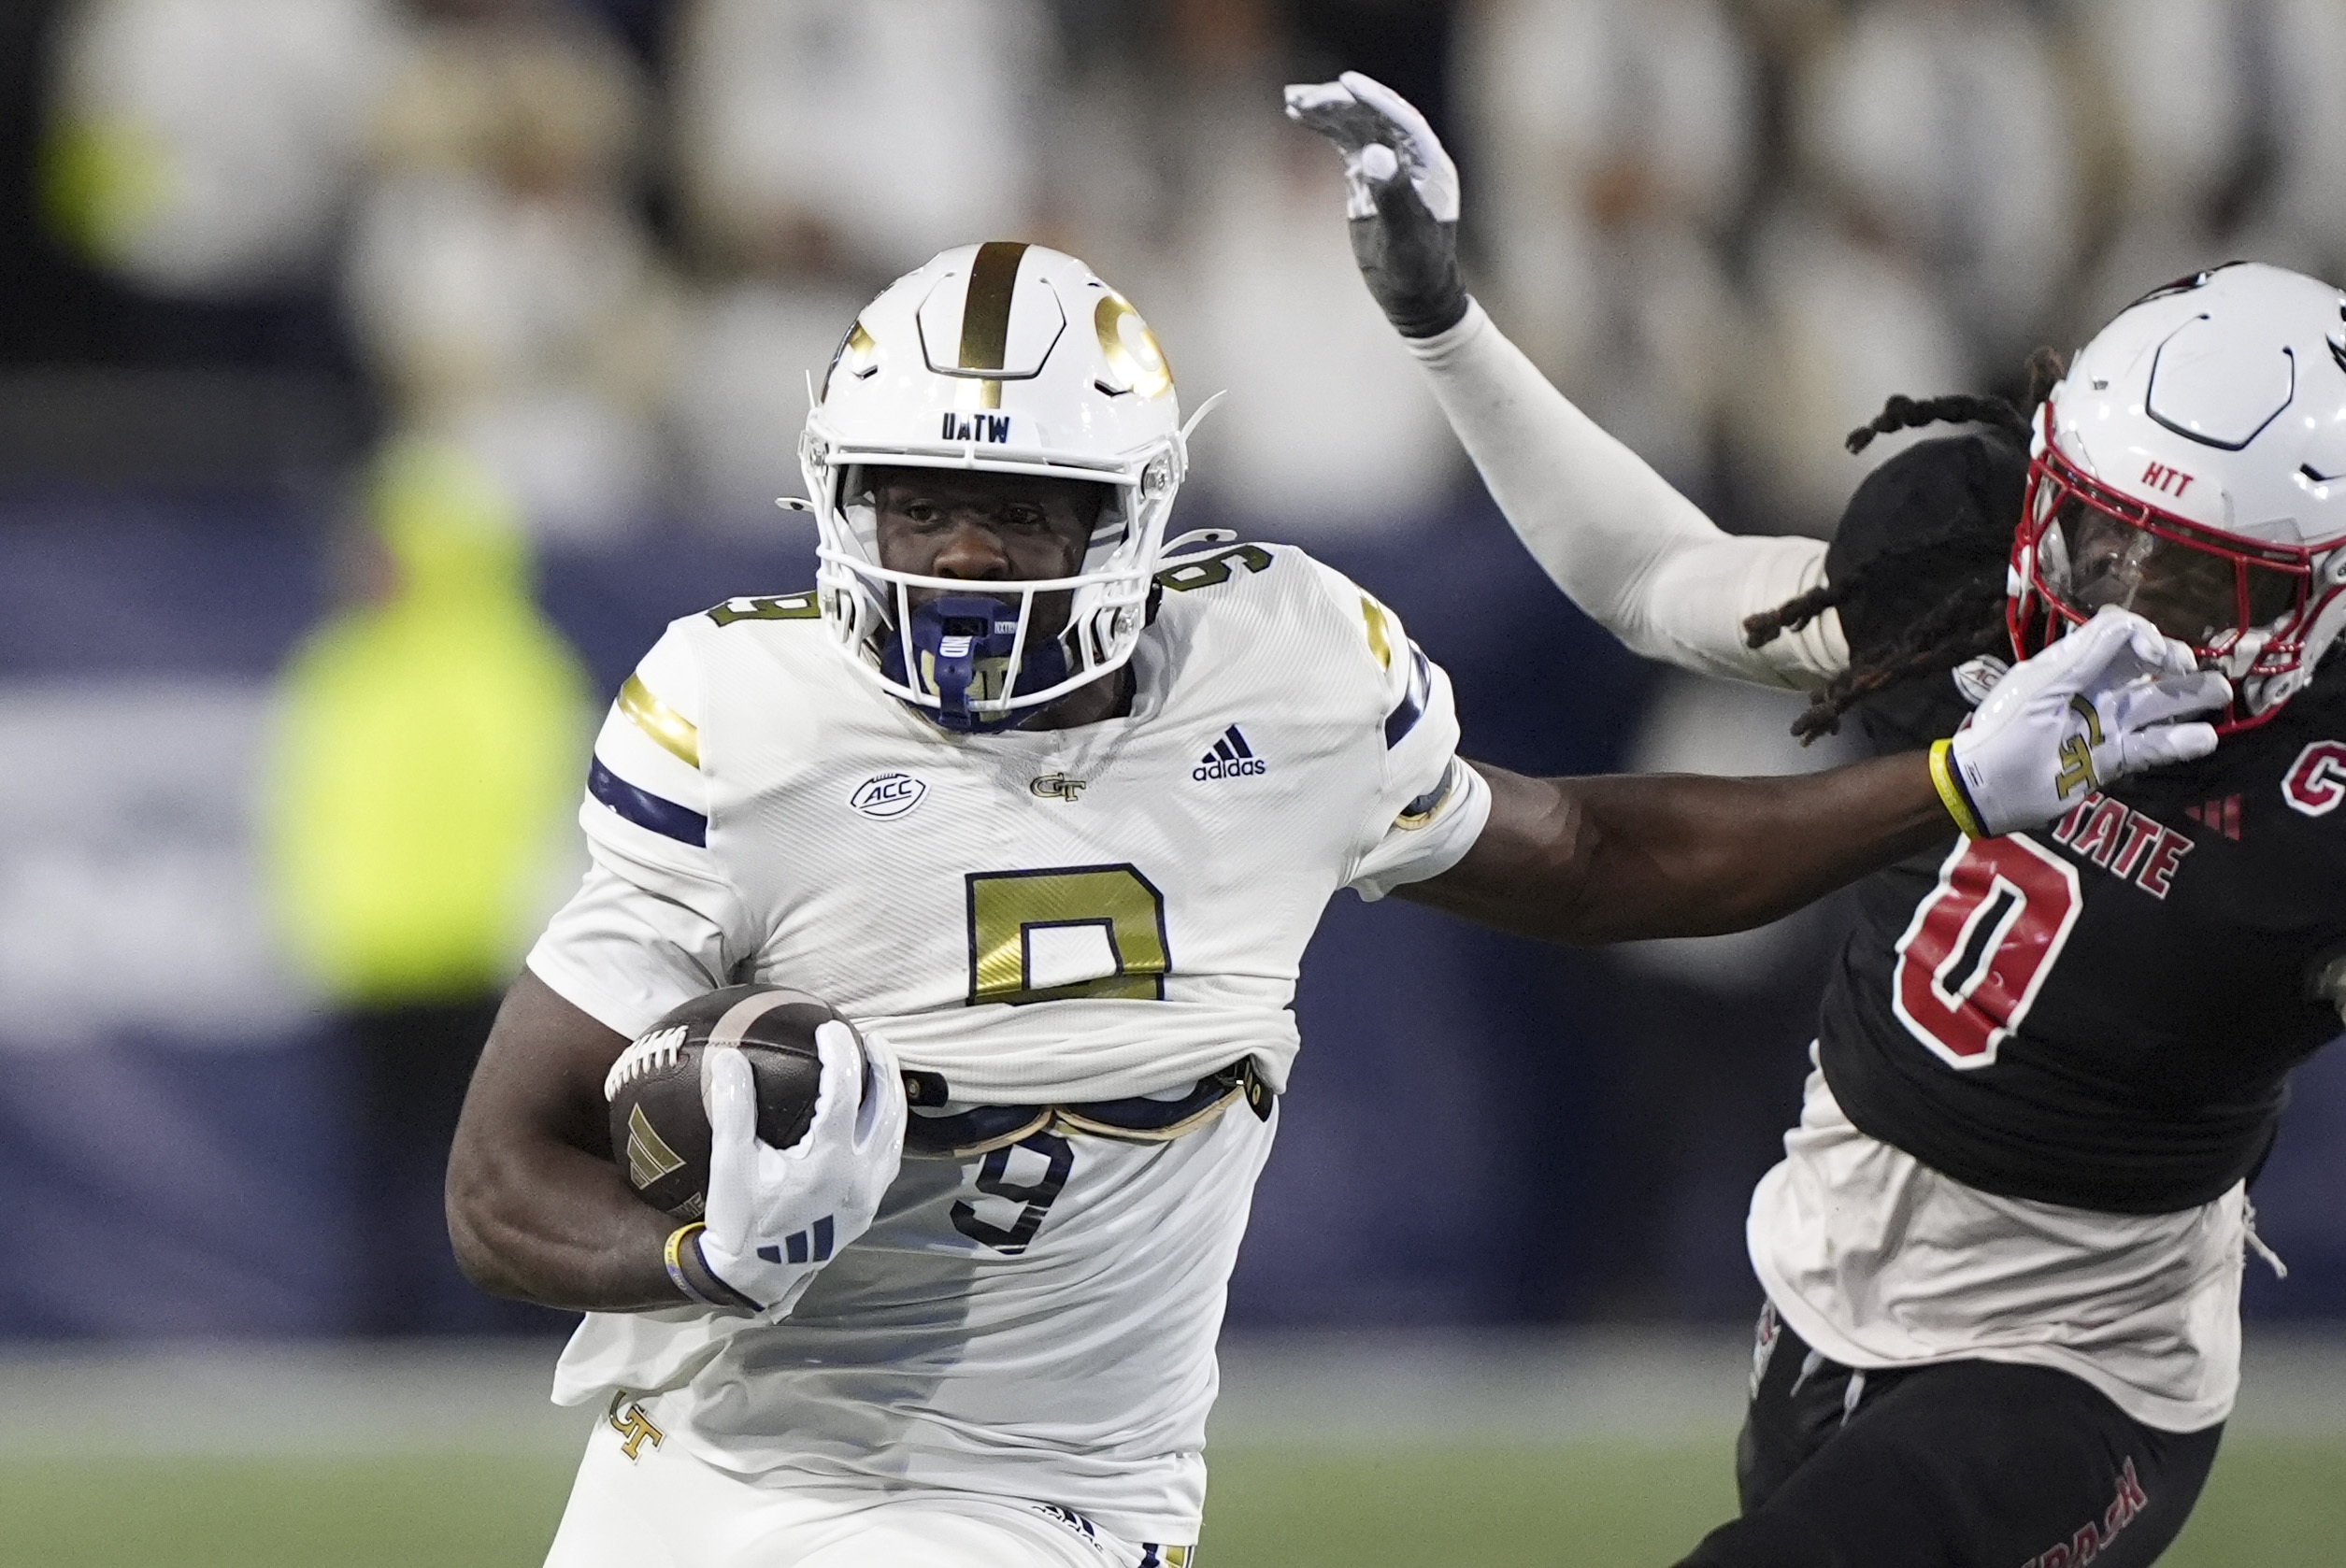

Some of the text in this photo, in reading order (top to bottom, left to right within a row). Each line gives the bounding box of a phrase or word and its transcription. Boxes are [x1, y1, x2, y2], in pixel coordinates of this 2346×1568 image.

[2141, 462, 2194, 497] HTT
[1965, 669, 2000, 688] AC
[1193, 757, 1266, 782] adidas
[2282, 739, 2346, 817] C
[864, 779, 912, 804] ACC
[1030, 773, 1086, 802] GT
[2052, 791, 2195, 900] TATE
[1892, 830, 2083, 1070] 0
[950, 1133, 1075, 1255] 9
